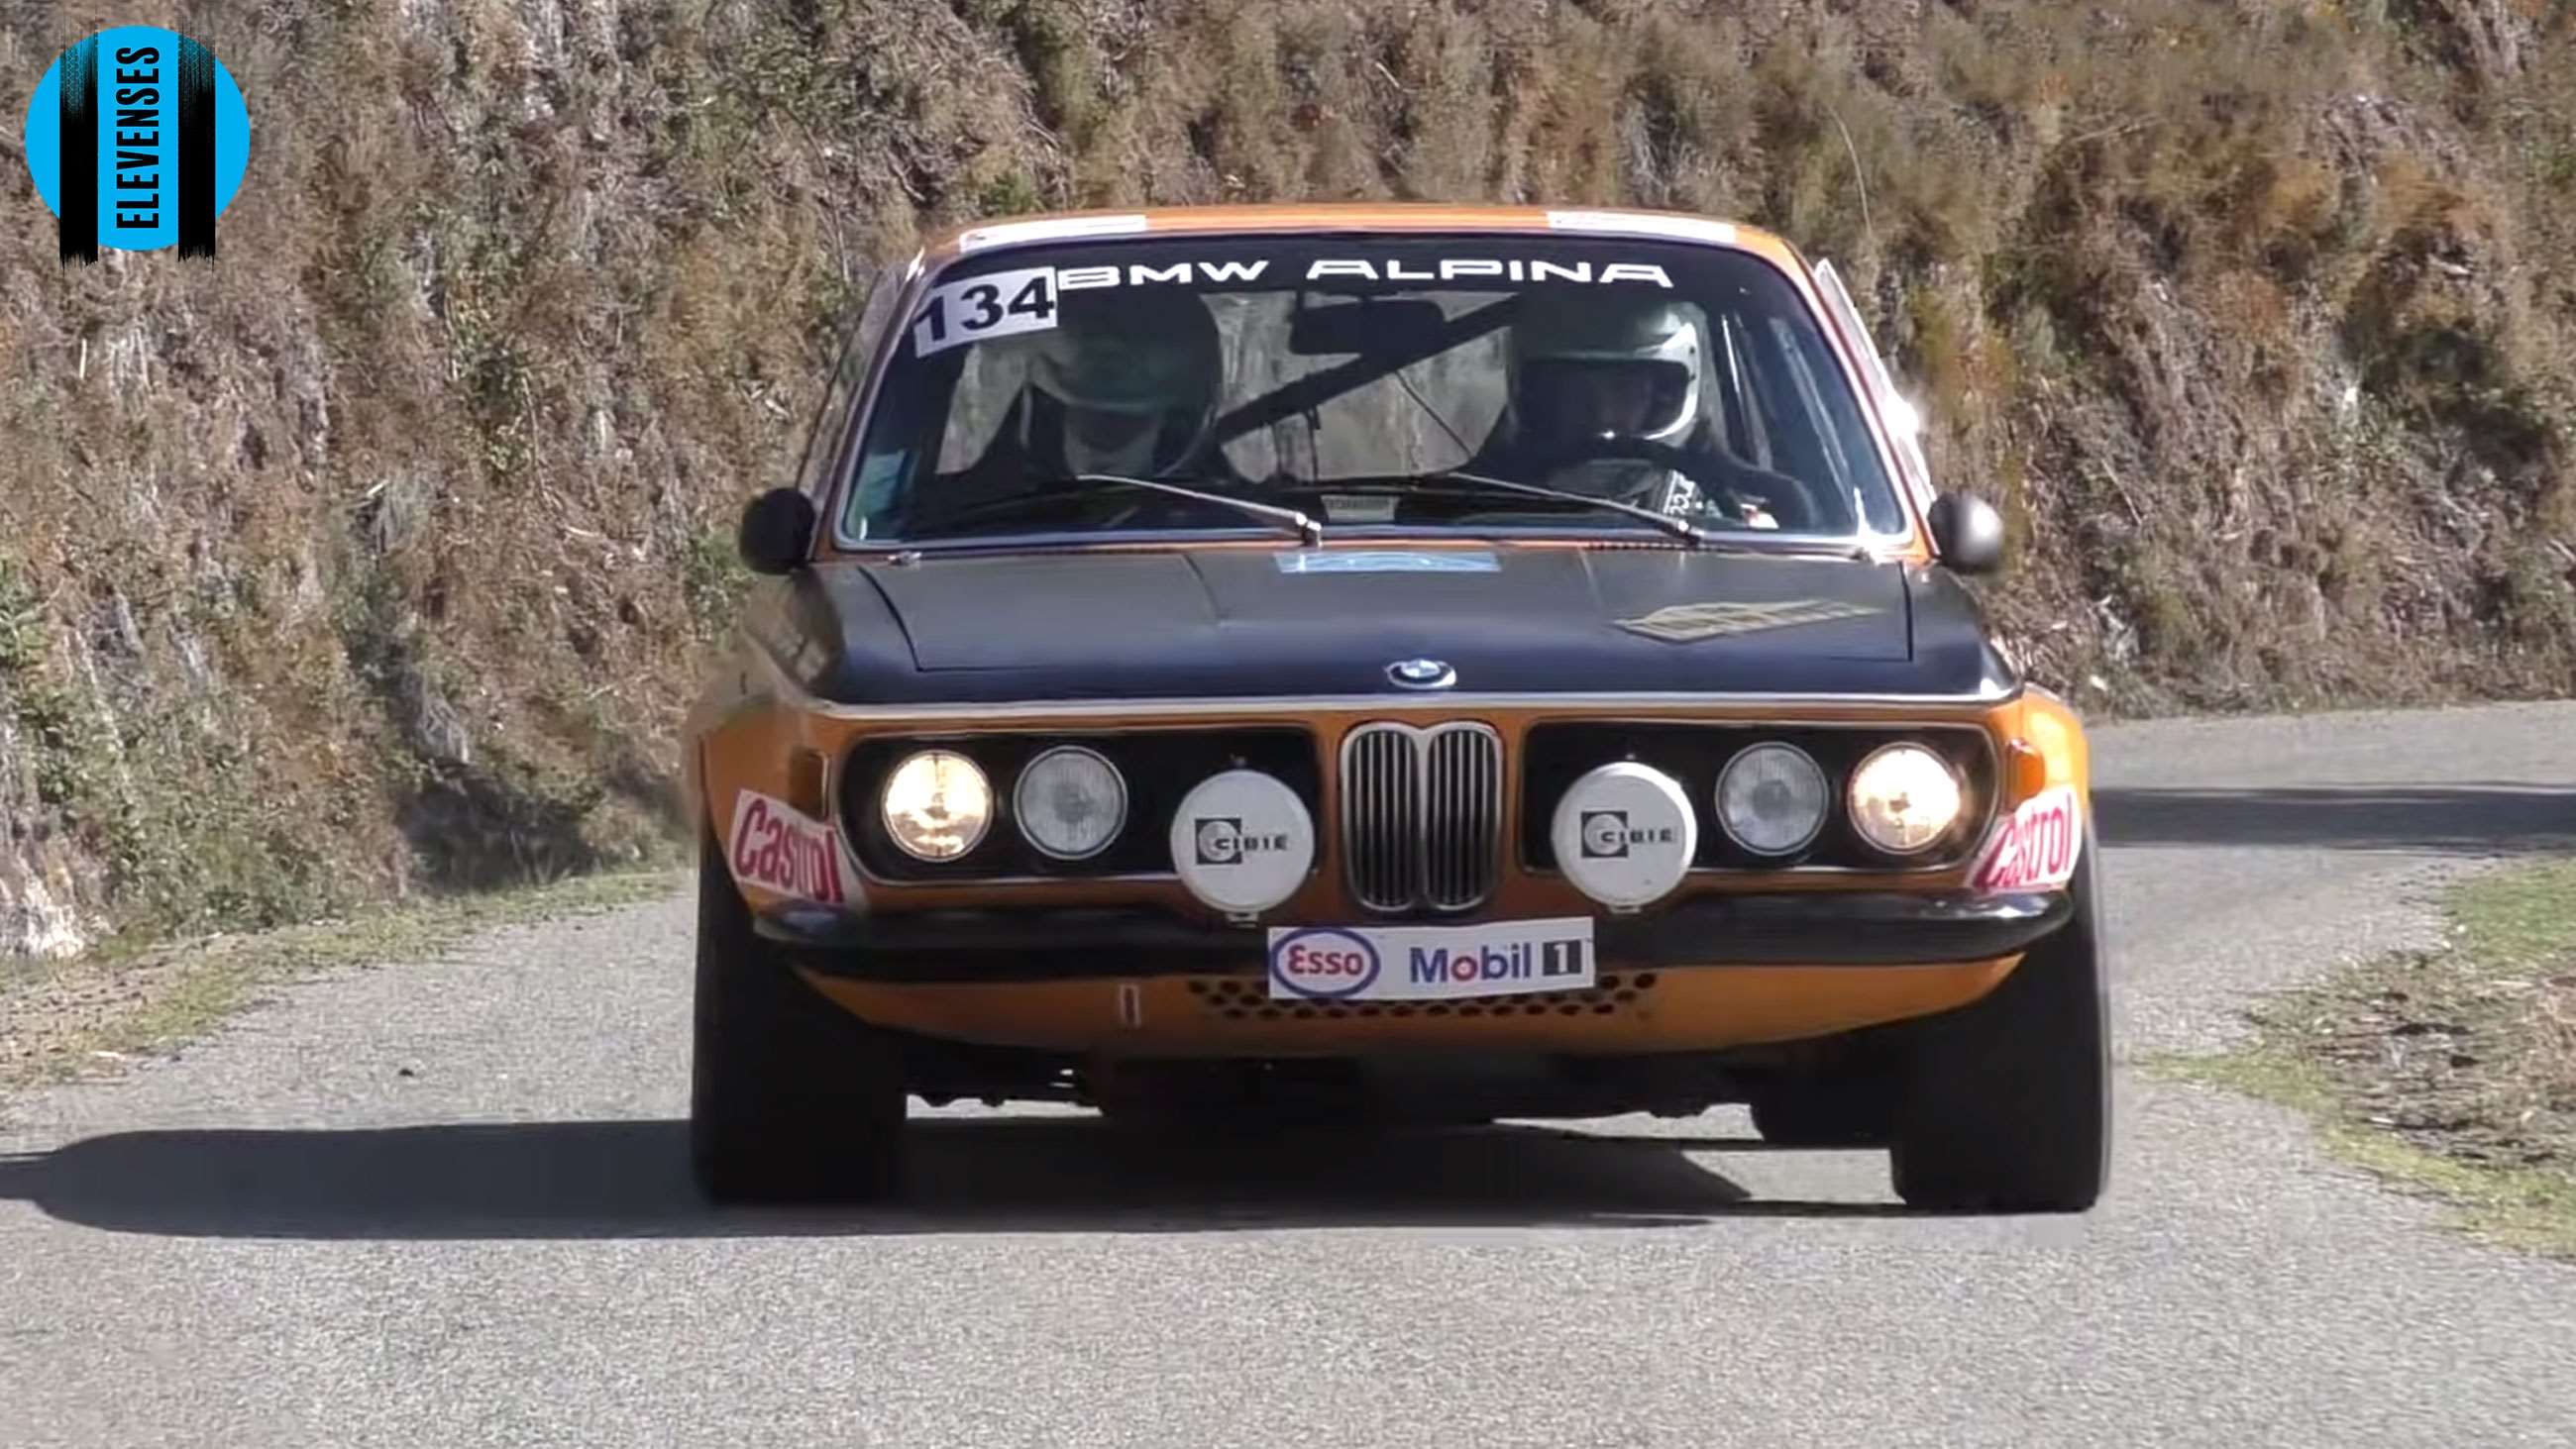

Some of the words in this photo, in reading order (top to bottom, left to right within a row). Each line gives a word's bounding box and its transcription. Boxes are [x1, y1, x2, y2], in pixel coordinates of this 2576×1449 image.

[1057, 260, 1269, 290] BMW
[1306, 259, 1674, 288] ALPINA
[914, 275, 1055, 342] 134
[1288, 944, 1364, 976] Esso
[1410, 942, 1532, 983] Mobil
